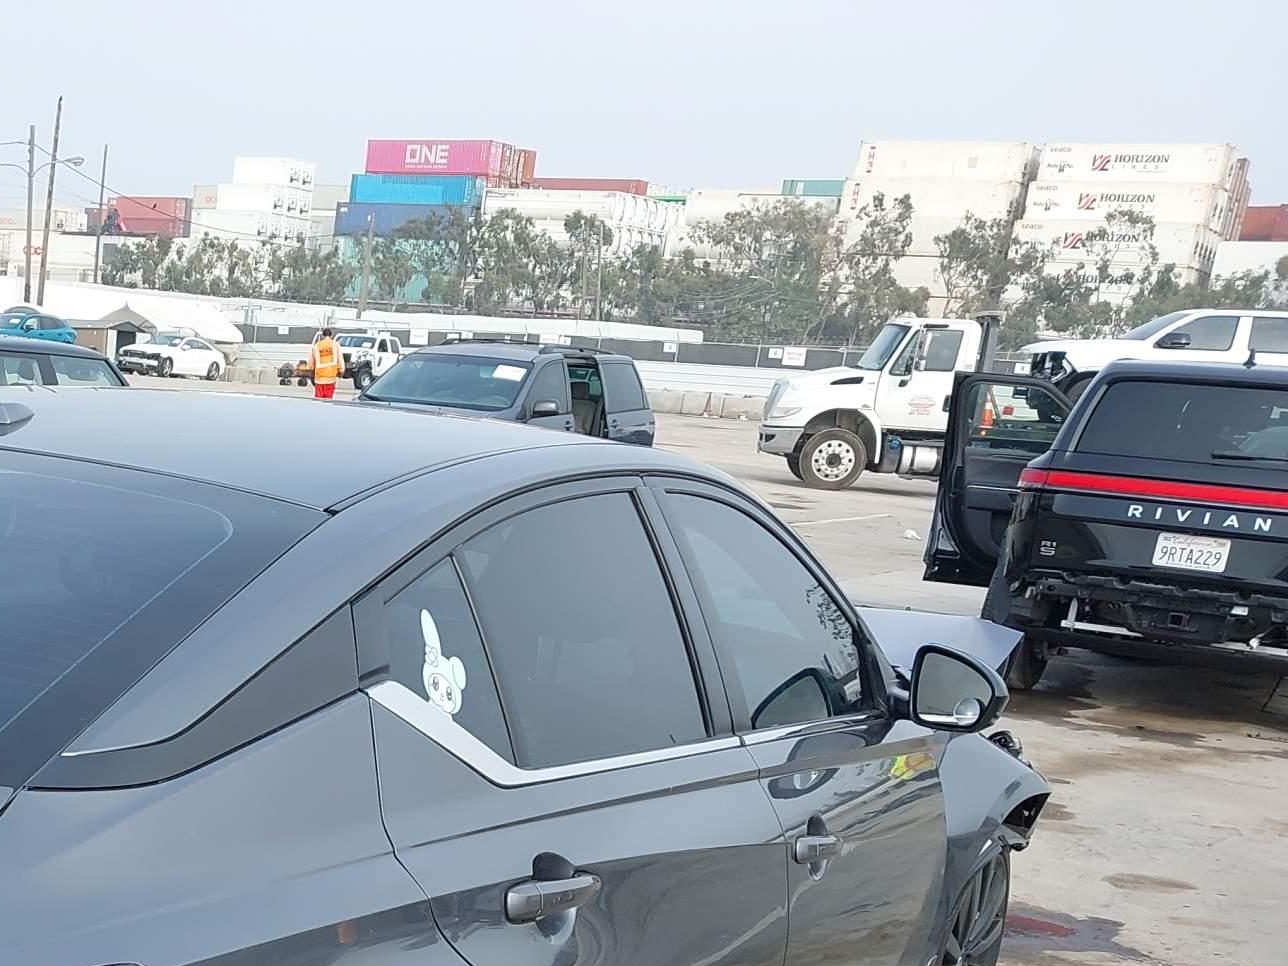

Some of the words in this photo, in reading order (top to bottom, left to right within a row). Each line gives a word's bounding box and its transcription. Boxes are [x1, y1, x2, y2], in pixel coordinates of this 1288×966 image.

[405, 144, 449, 164] ONE
[1113, 154, 1170, 164] HORIZON
[1100, 193, 1155, 203] HORIZON
[1127, 504, 1272, 531] RIVIAN
[1040, 547, 1055, 556] S
[1158, 546, 1222, 567] 9RTA229
